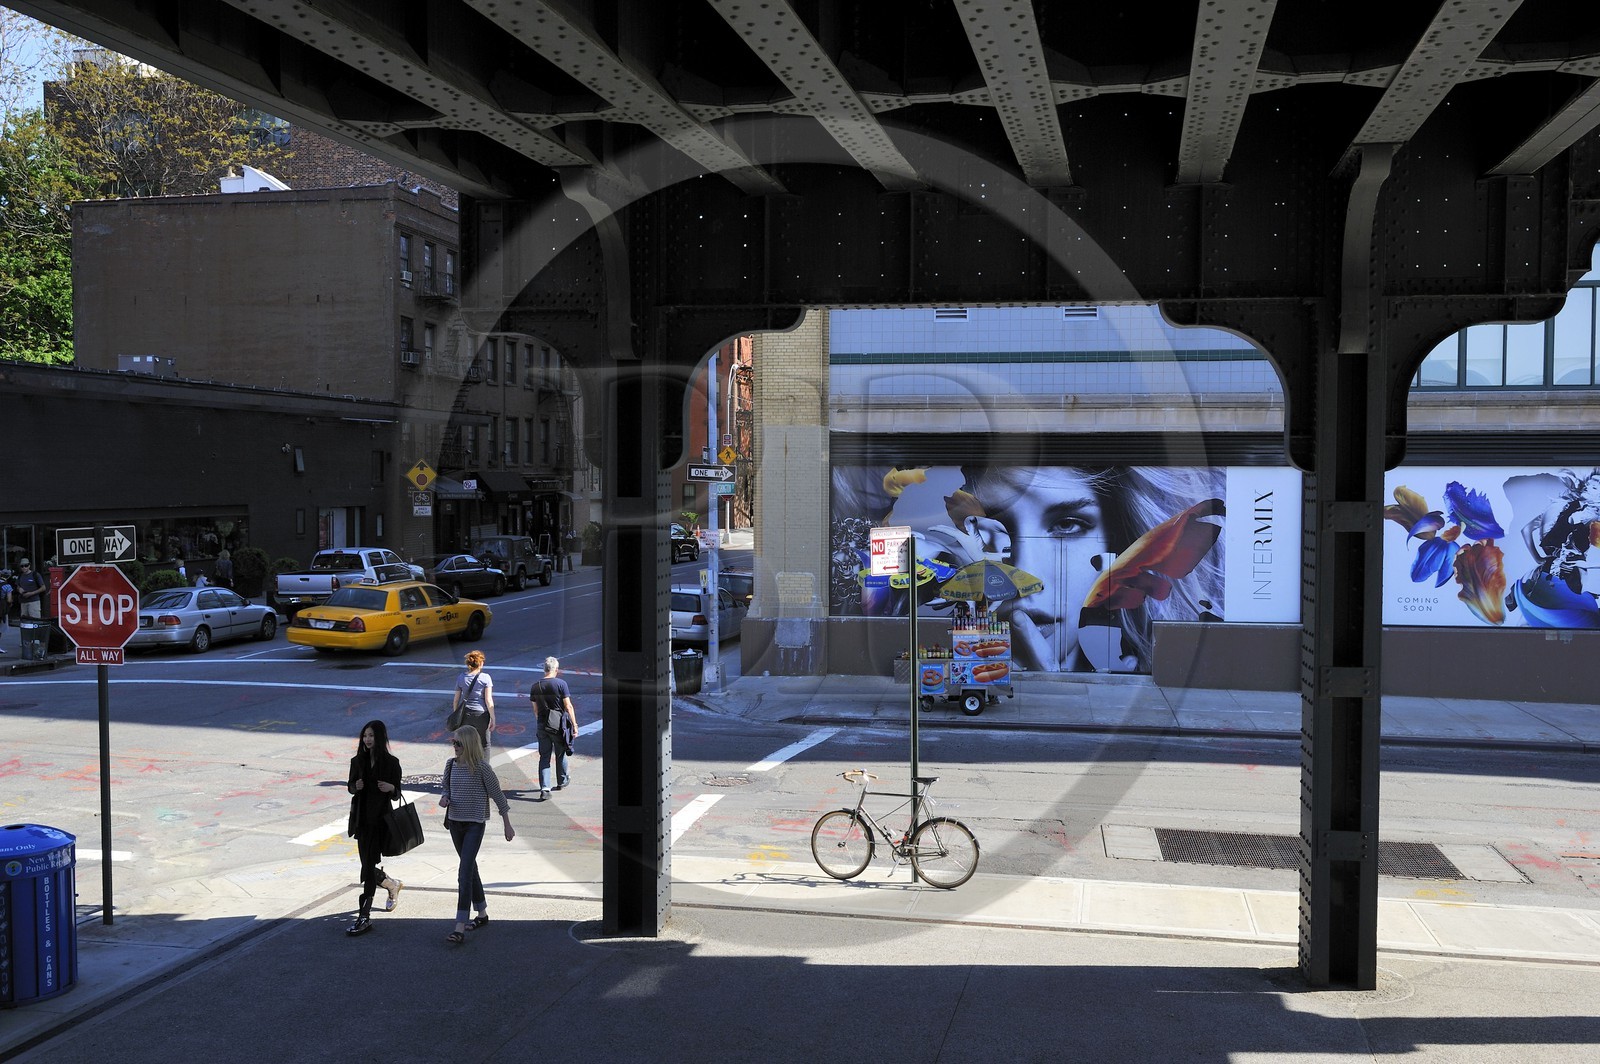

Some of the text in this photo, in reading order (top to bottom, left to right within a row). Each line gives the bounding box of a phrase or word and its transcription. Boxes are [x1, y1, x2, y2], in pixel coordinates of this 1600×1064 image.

[694, 469, 708, 477] ONE
[69, 537, 125, 554] ONE WAY
[872, 541, 884, 553] NO
[1252, 489, 1274, 600] INTERMIX
[943, 589, 981, 599] SABRETT
[1397, 596, 1439, 604] COMING
[65, 592, 134, 626] STOP
[1403, 604, 1432, 612] SOON
[79, 650, 120, 661] ALL WAY
[29, 856, 45, 865] New
[25, 863, 50, 874] Public
[45, 940, 52, 948] &
